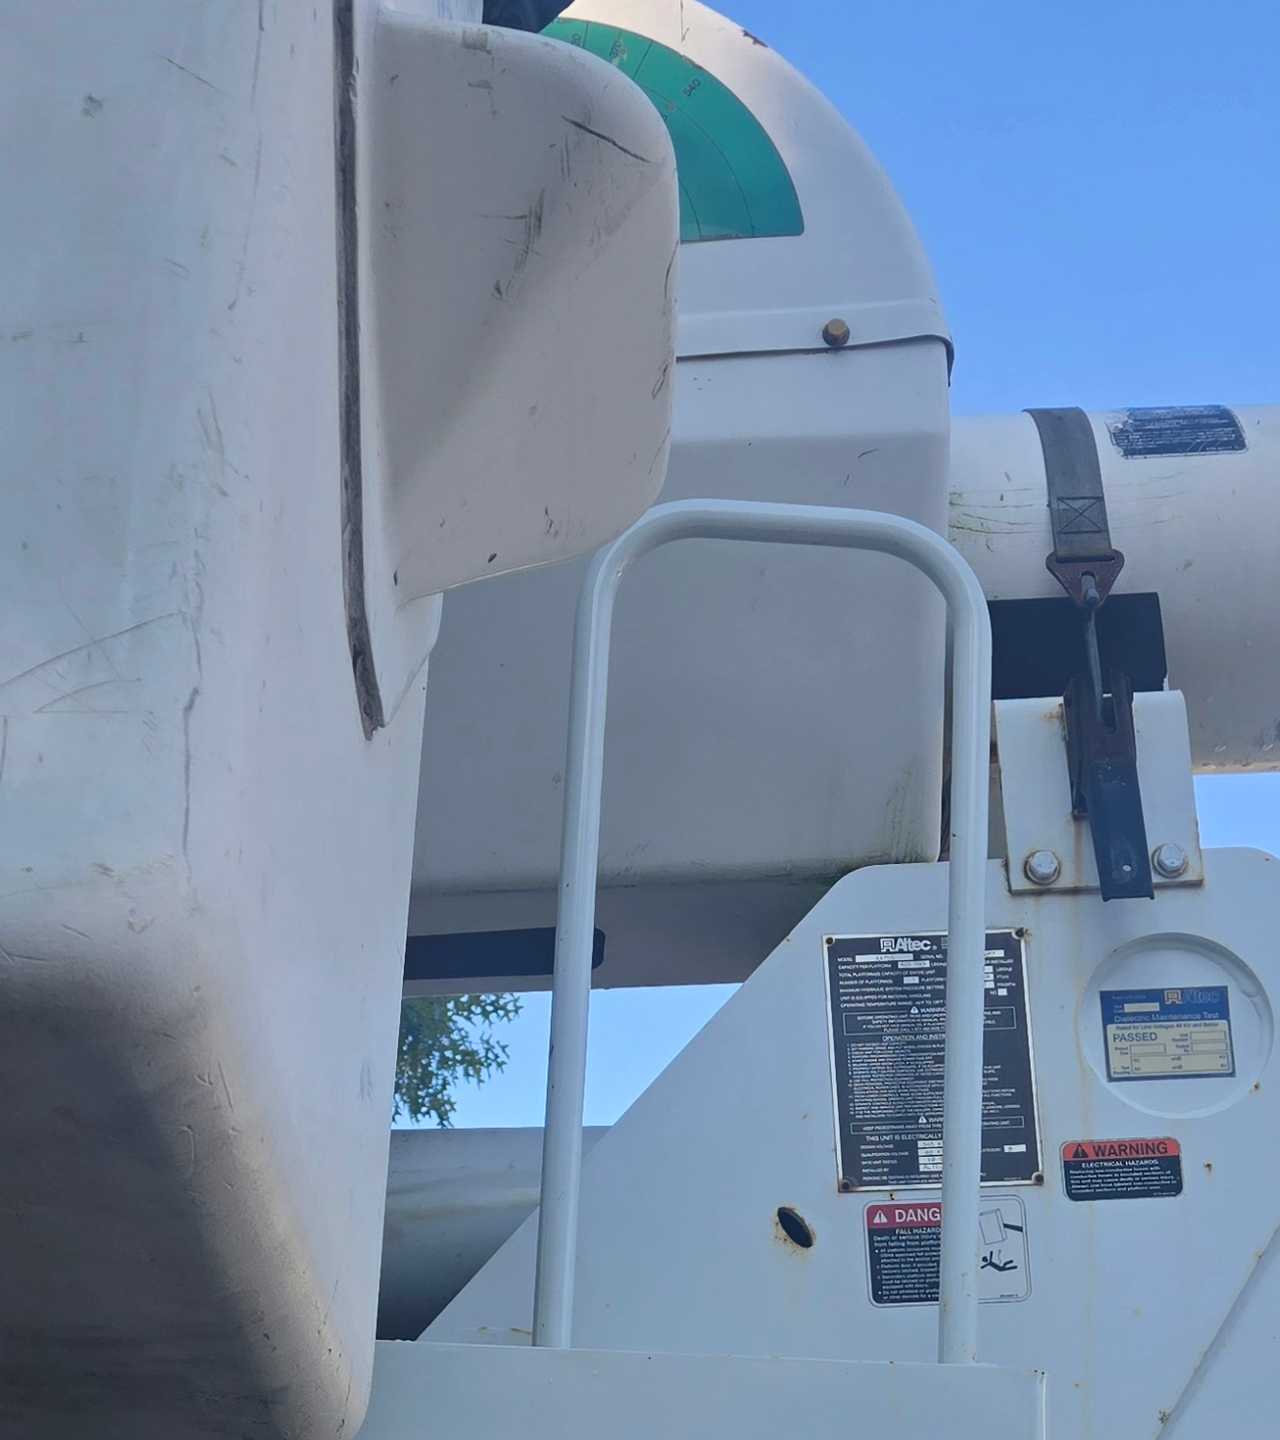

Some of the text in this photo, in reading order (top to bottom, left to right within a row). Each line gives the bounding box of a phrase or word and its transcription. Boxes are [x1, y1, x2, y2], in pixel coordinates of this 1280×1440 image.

[896, 938, 931, 952] Altec
[1112, 1031, 1158, 1042] PASSED
[1092, 1142, 1168, 1157] WARNING
[1081, 1161, 1123, 1169] ELECTRICAL
[895, 1208, 941, 1222] DANG
